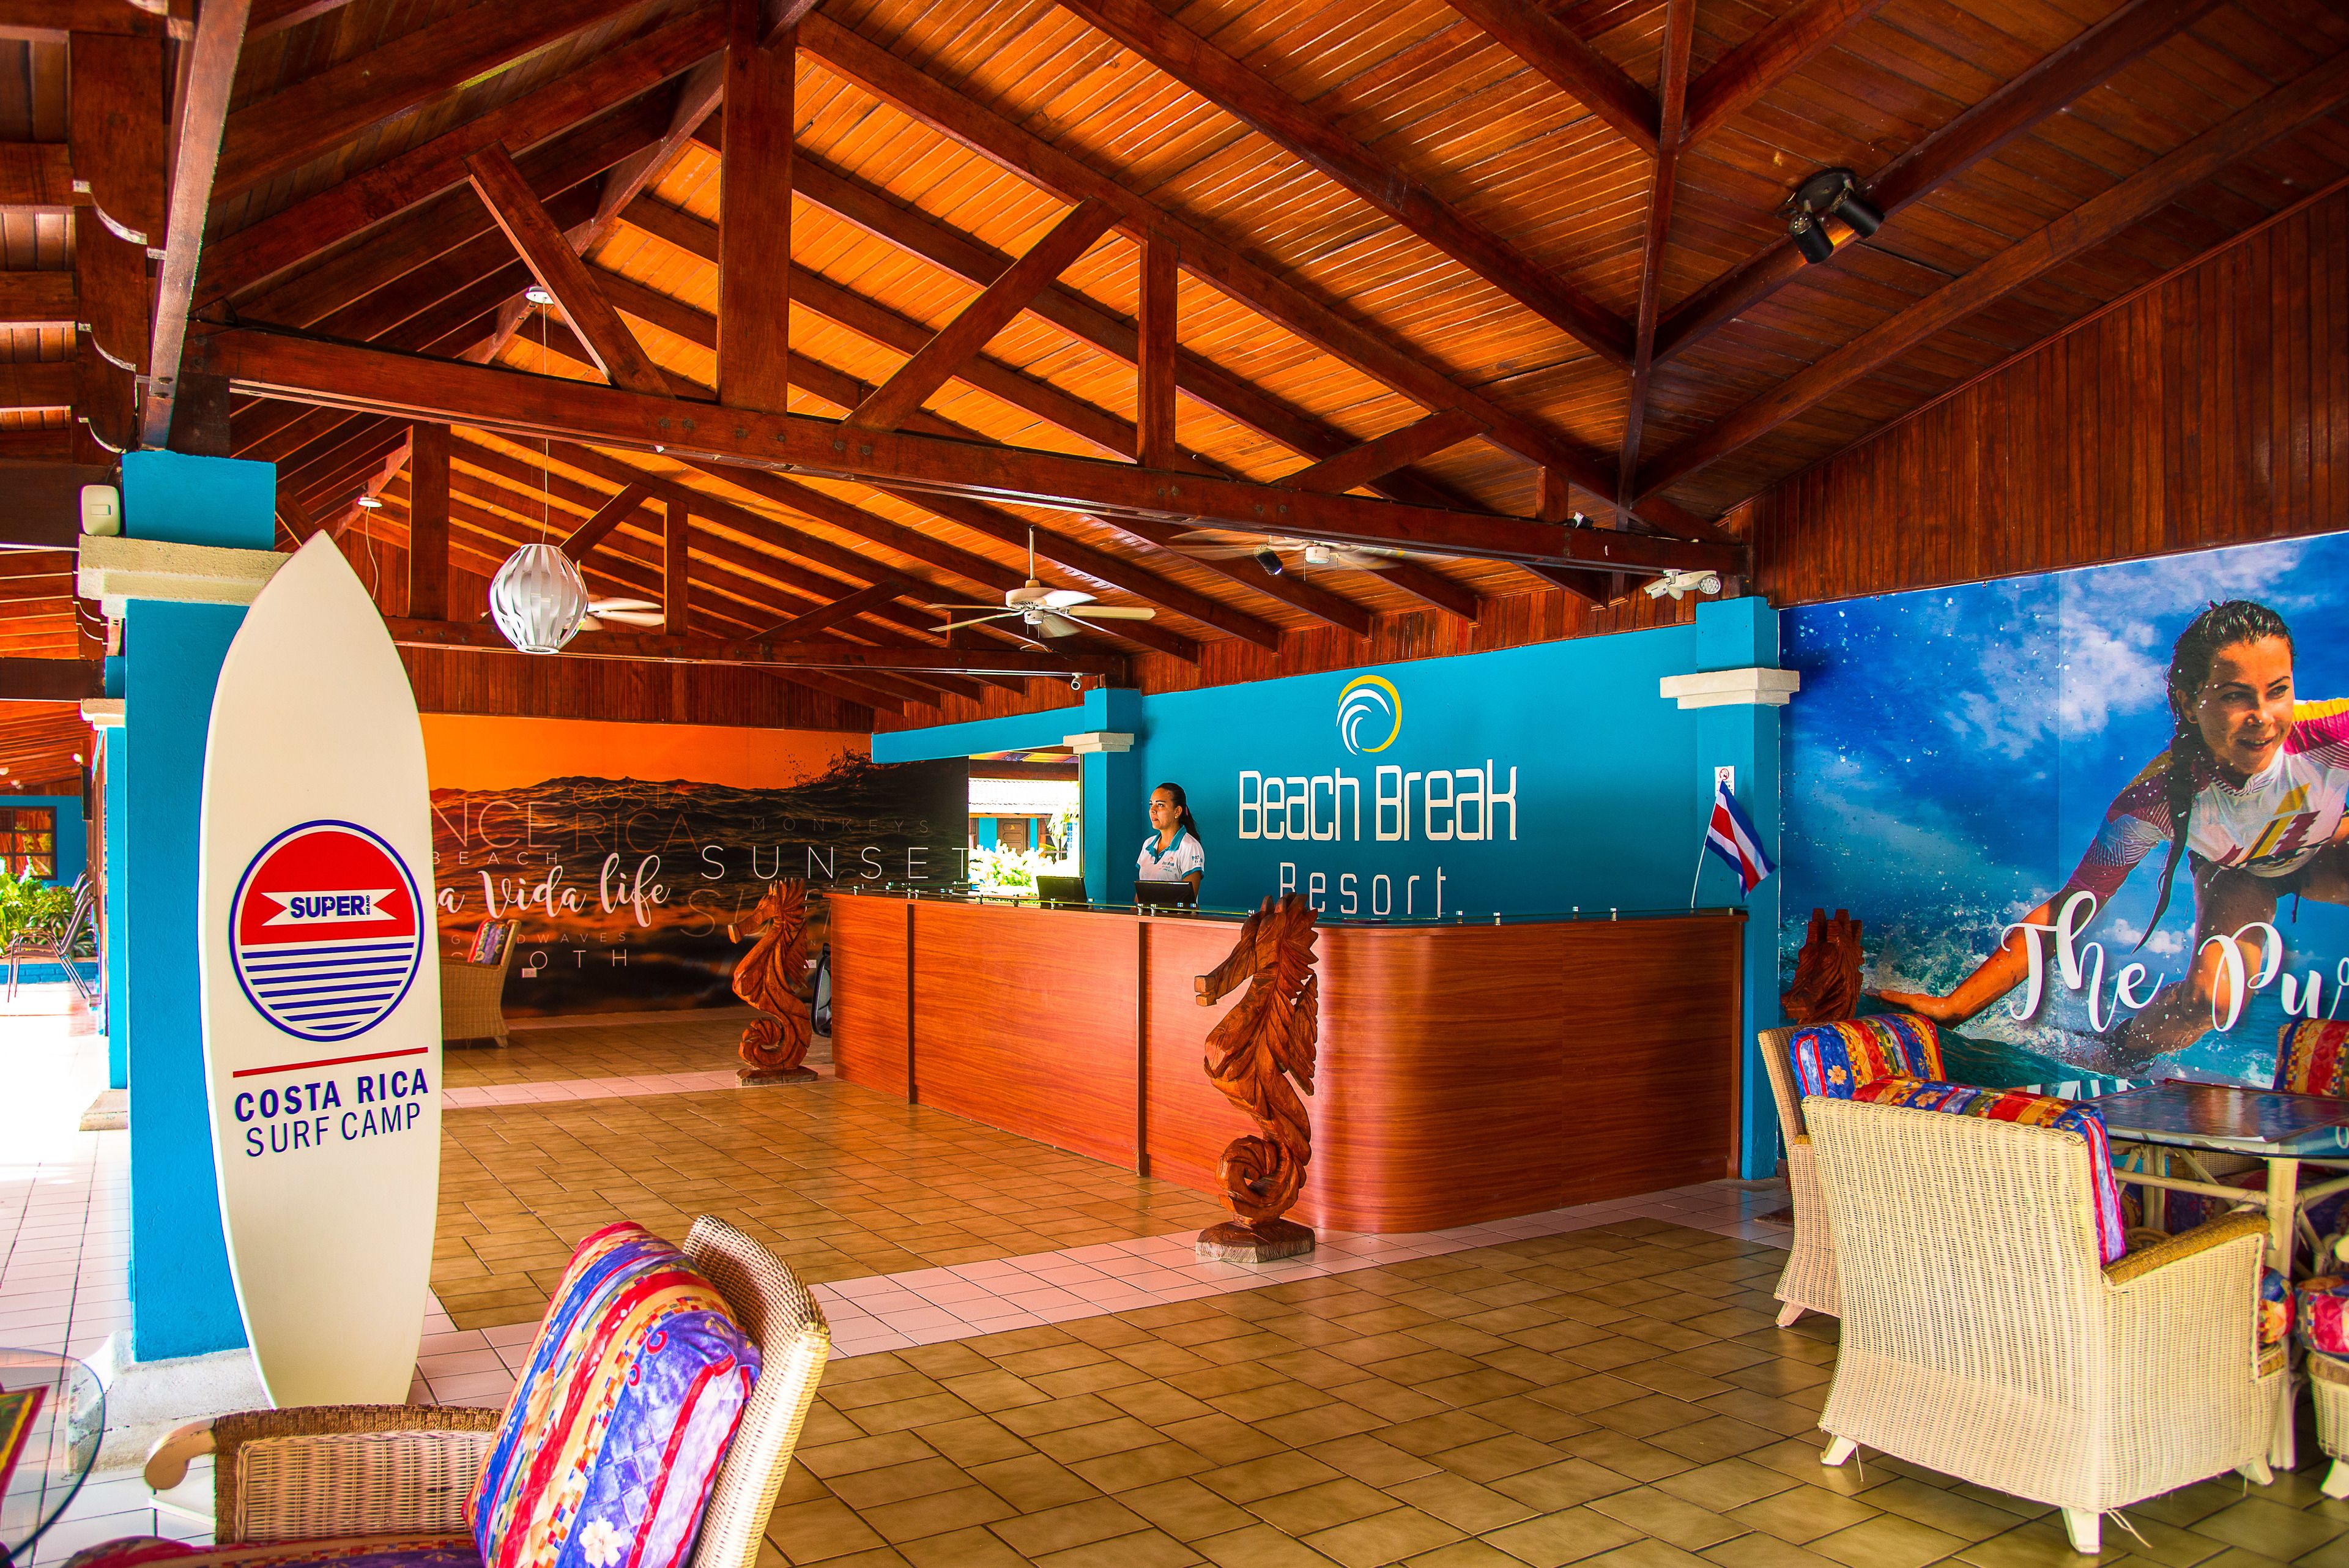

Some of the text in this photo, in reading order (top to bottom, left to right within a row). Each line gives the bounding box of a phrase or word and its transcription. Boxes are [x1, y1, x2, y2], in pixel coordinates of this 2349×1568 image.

[573, 782, 691, 811] COSTA
[1239, 759, 1518, 841] Beach Break
[575, 812, 699, 853] RICA
[752, 817, 929, 833] MONKEYS
[432, 852, 558, 865] BEACH
[700, 845, 968, 880] SUNSET
[290, 895, 365, 918] SUPER
[478, 865, 587, 919] Vida
[599, 852, 670, 928] life
[1279, 861, 1447, 918] Resort
[2001, 891, 2164, 1033] The
[234, 1068, 429, 1122] COSTA RICA
[246, 1102, 421, 1157] SURF CAMP
